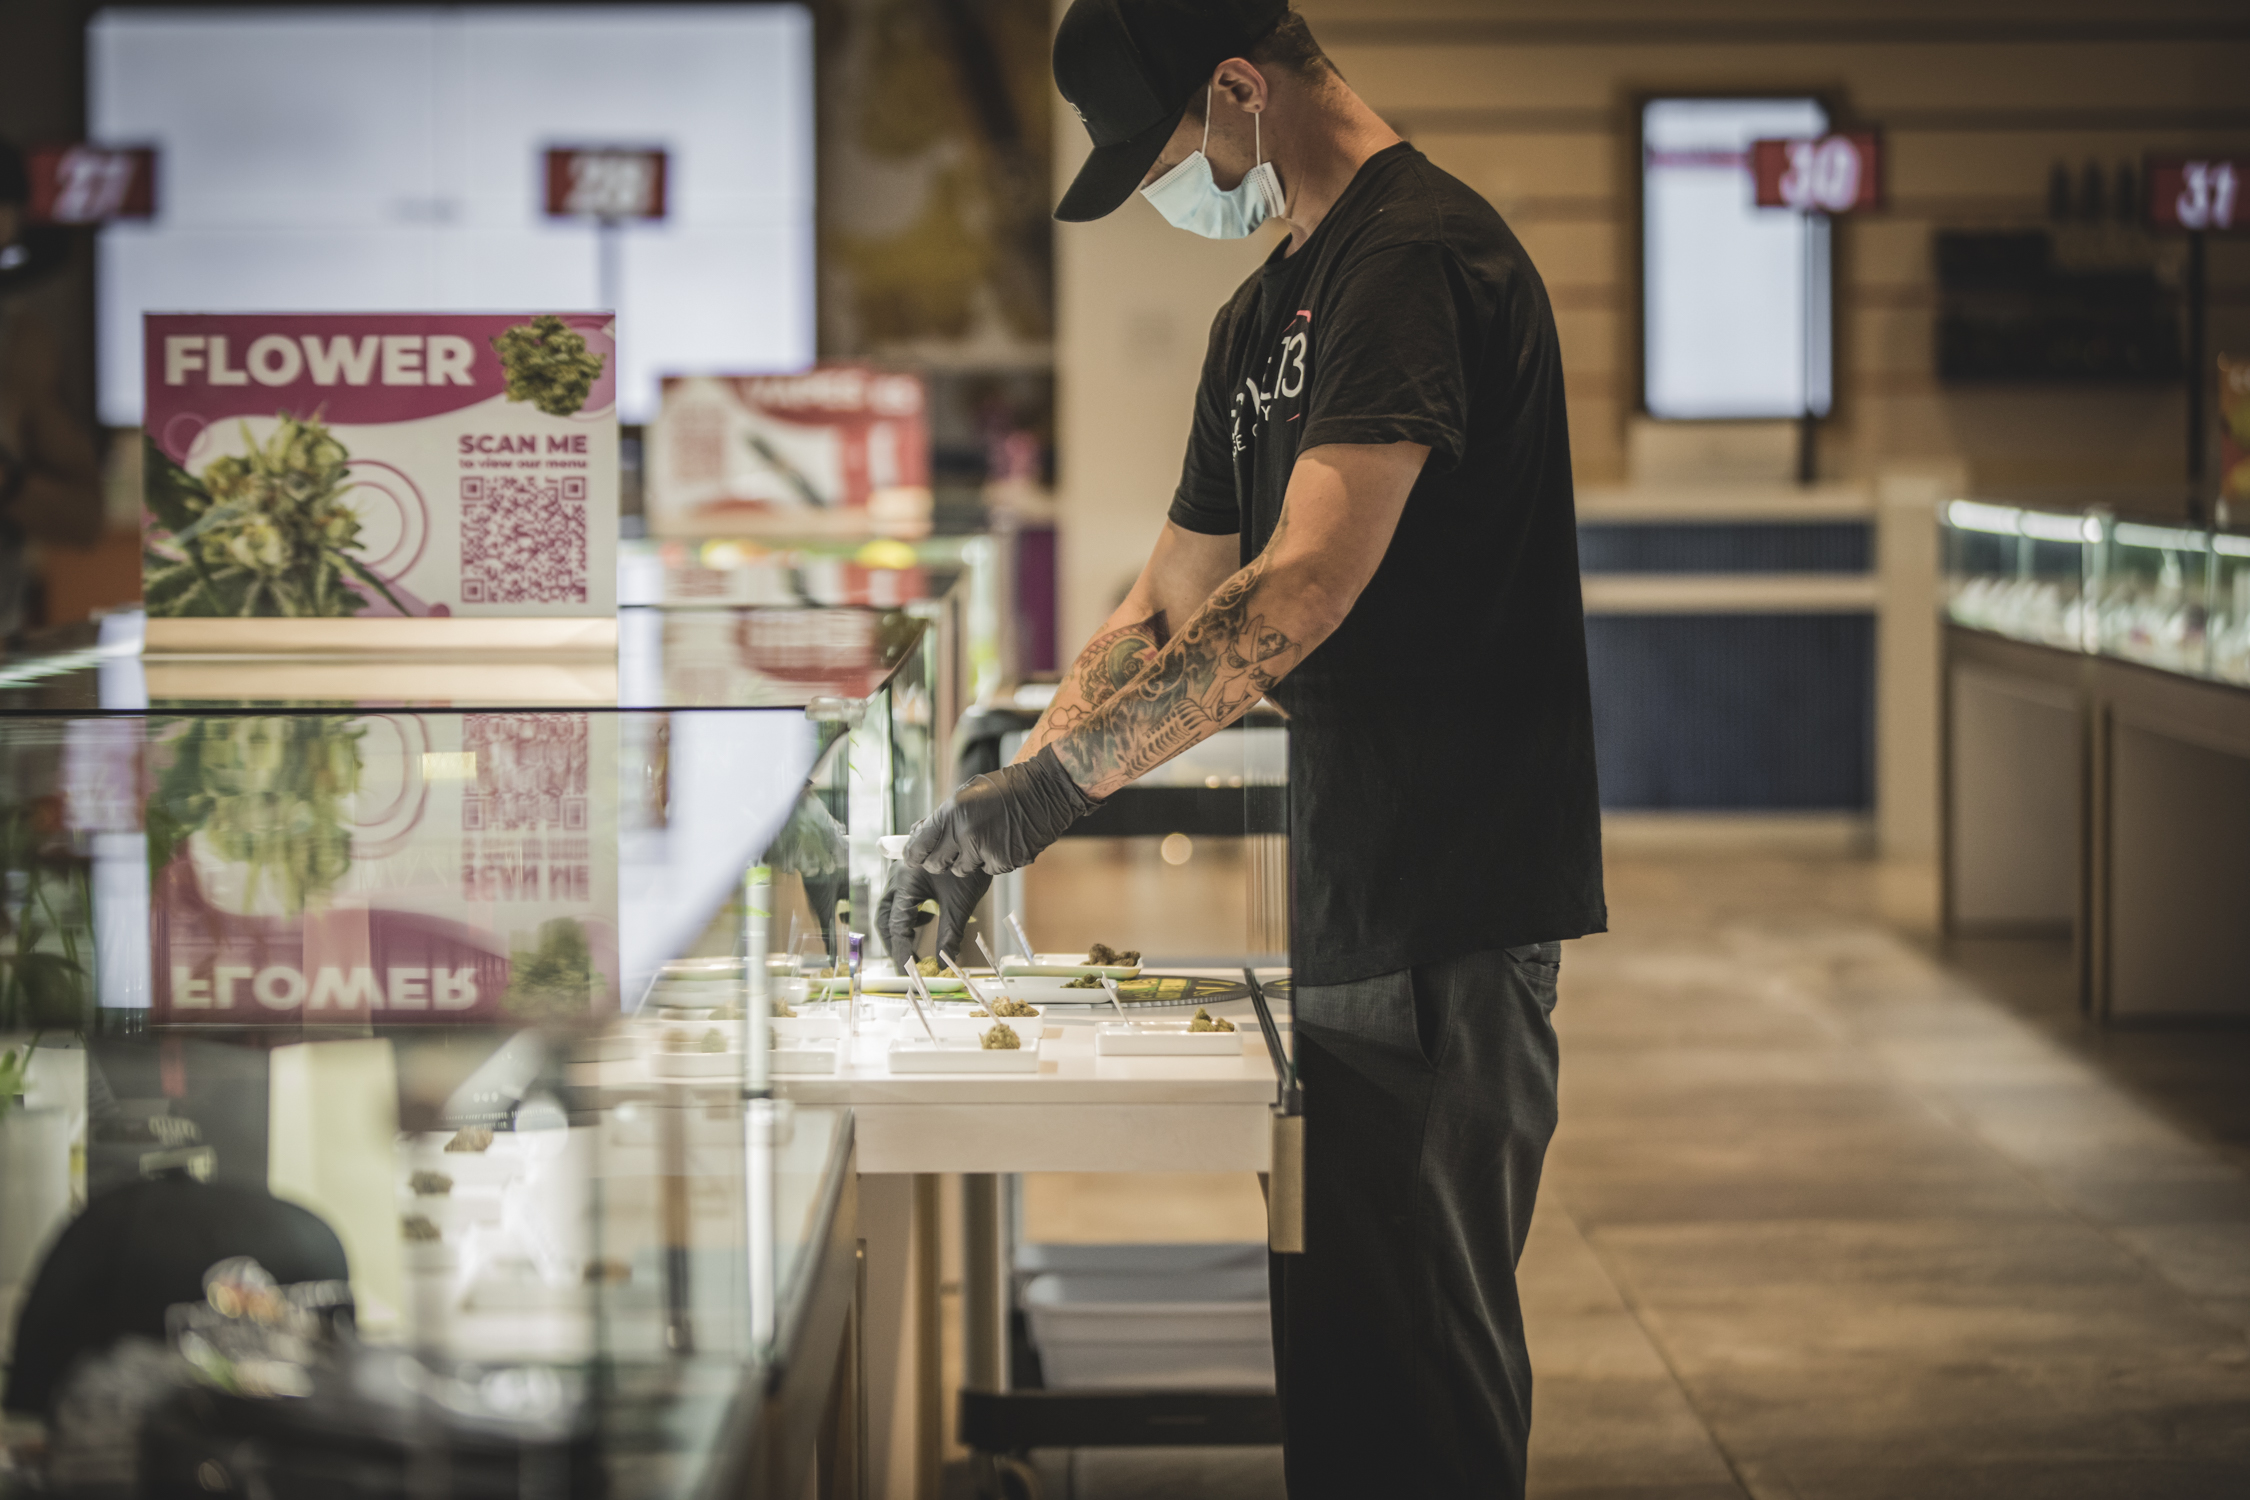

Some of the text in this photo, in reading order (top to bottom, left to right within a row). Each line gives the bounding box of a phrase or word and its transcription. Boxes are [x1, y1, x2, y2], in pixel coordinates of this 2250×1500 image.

[1779, 134, 1862, 213] 30
[2176, 159, 2238, 230] 31
[163, 335, 476, 387] FLOWER
[458, 434, 588, 454] SCAN ME
[459, 457, 588, 469] to view our menu
